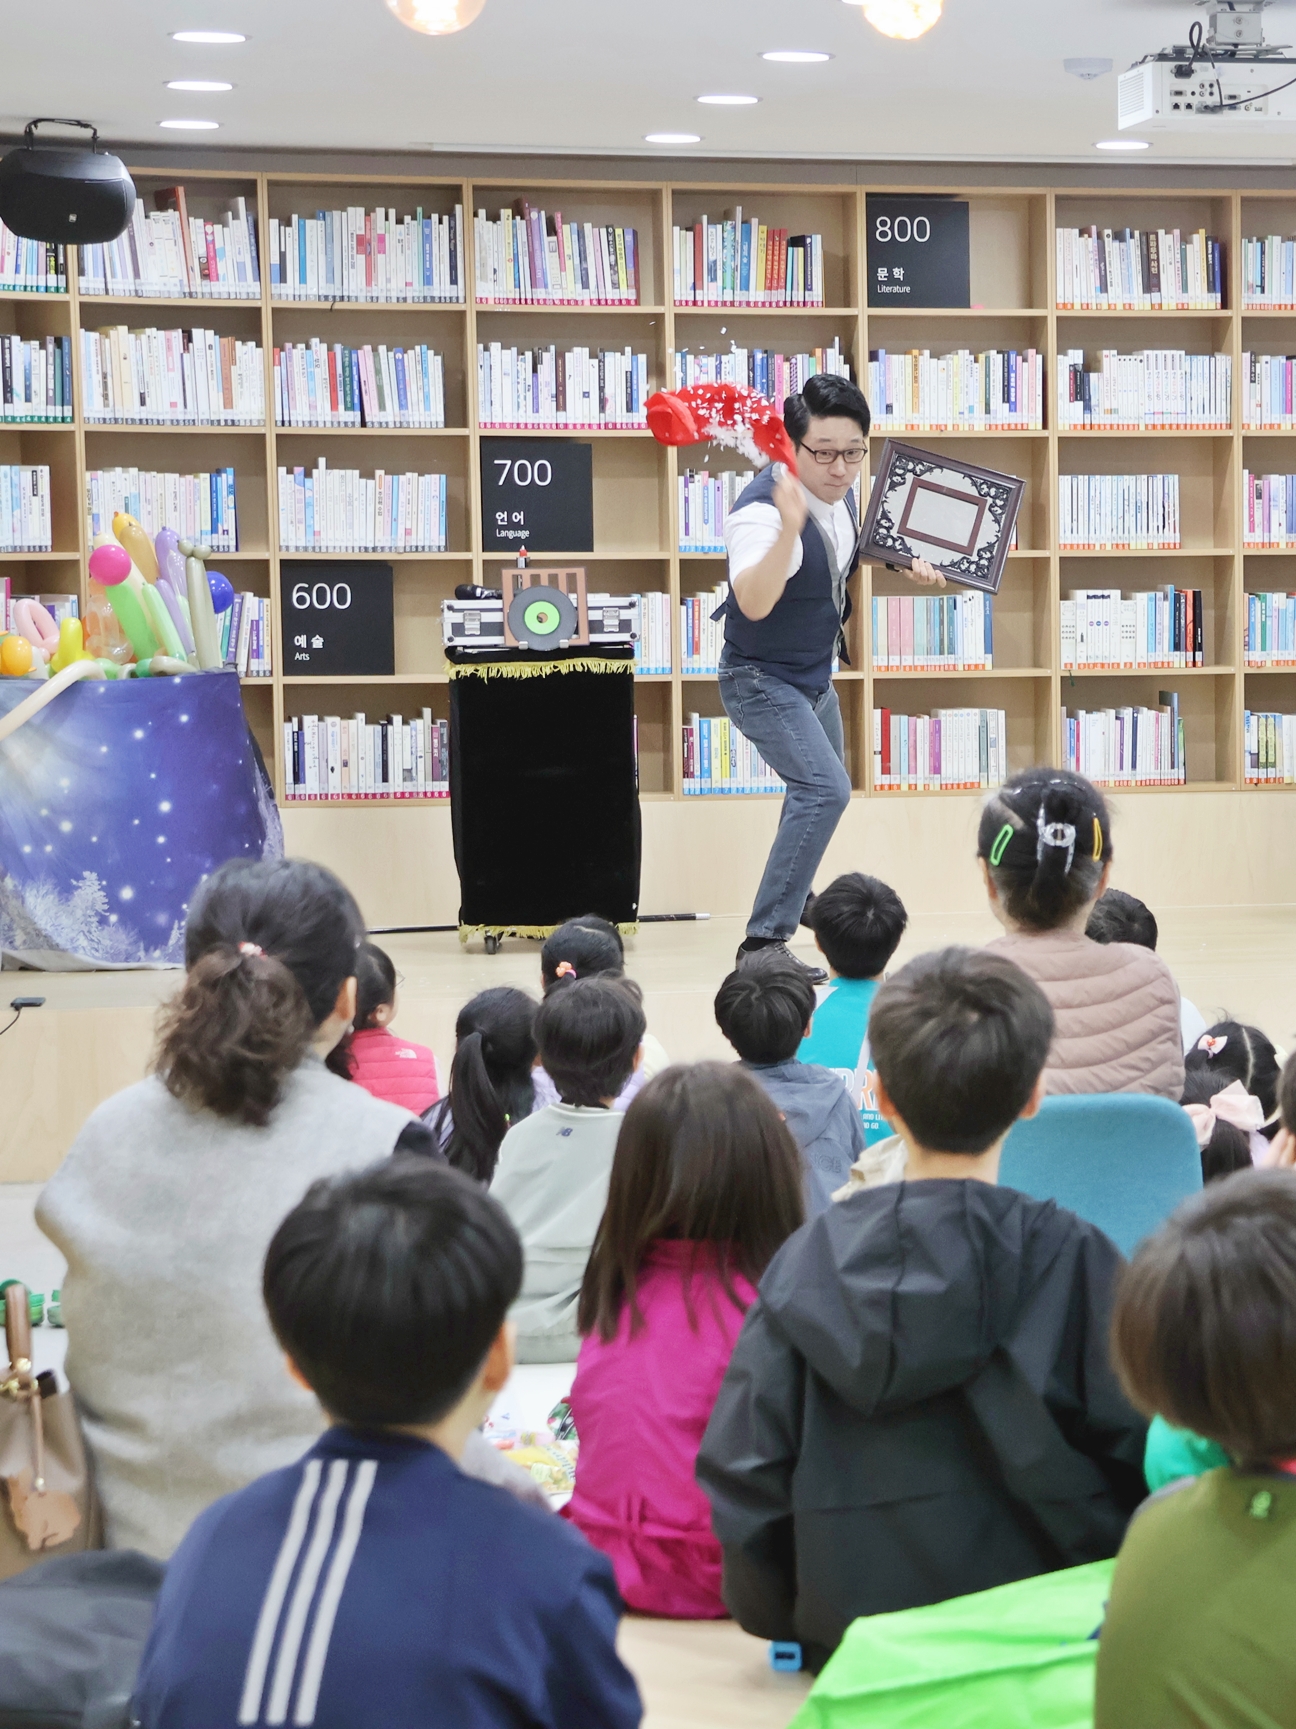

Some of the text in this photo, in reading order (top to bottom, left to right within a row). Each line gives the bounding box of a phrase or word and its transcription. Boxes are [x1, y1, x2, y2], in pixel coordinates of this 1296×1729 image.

[875, 216, 931, 243] 800
[877, 284, 911, 293] Literature
[493, 459, 552, 486] 700
[496, 528, 530, 539] Language
[292, 582, 352, 610] 600
[294, 652, 310, 661] Arts
